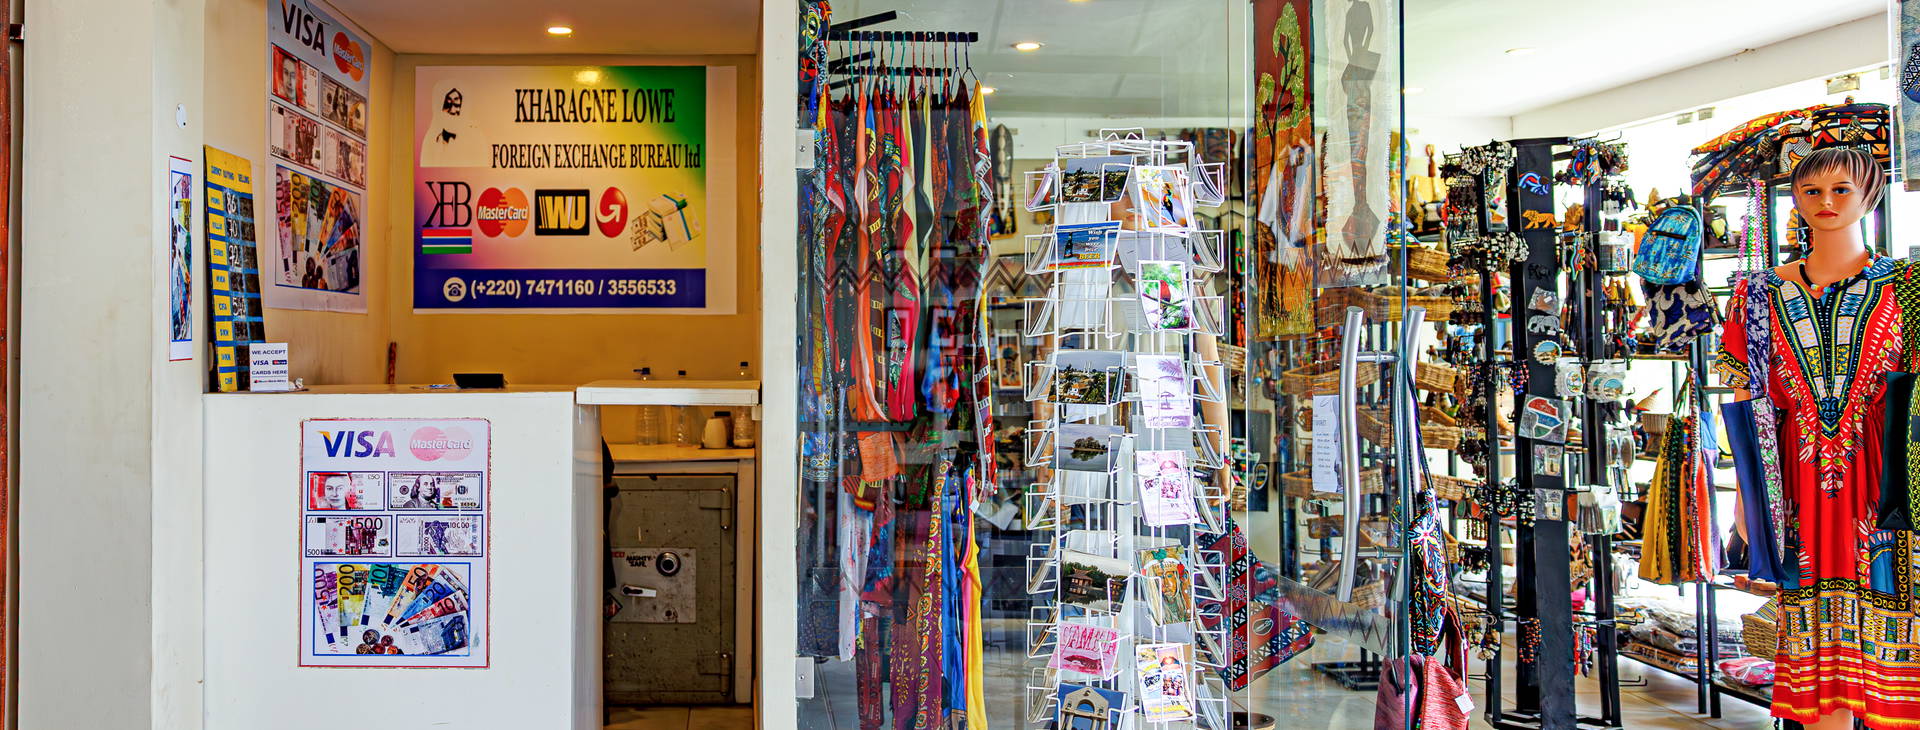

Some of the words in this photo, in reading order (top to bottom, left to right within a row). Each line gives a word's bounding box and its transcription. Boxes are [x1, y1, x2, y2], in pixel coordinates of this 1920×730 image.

[281, 0, 325, 56] VISA
[514, 88, 618, 123] KHARAGNE
[622, 88, 675, 123] LOWE
[492, 143, 551, 169] FOREIGN
[554, 143, 627, 169] EXCHANGE
[629, 143, 682, 169] BUREAU
[684, 143, 701, 169] ltd
[226, 192, 237, 214] 86
[477, 204, 529, 222] MasterCard
[538, 195, 587, 230] WU
[227, 218, 238, 238] 70
[470, 279, 522, 300] (+220)
[525, 279, 595, 296] 7471160
[598, 279, 603, 295] /
[607, 279, 677, 296] 3556533
[317, 430, 396, 458] VISA
[410, 439, 472, 450] MasterCard
[355, 517, 383, 531] 500
[307, 548, 320, 556] 500
[407, 567, 428, 586] 50
[437, 597, 455, 615] 10
